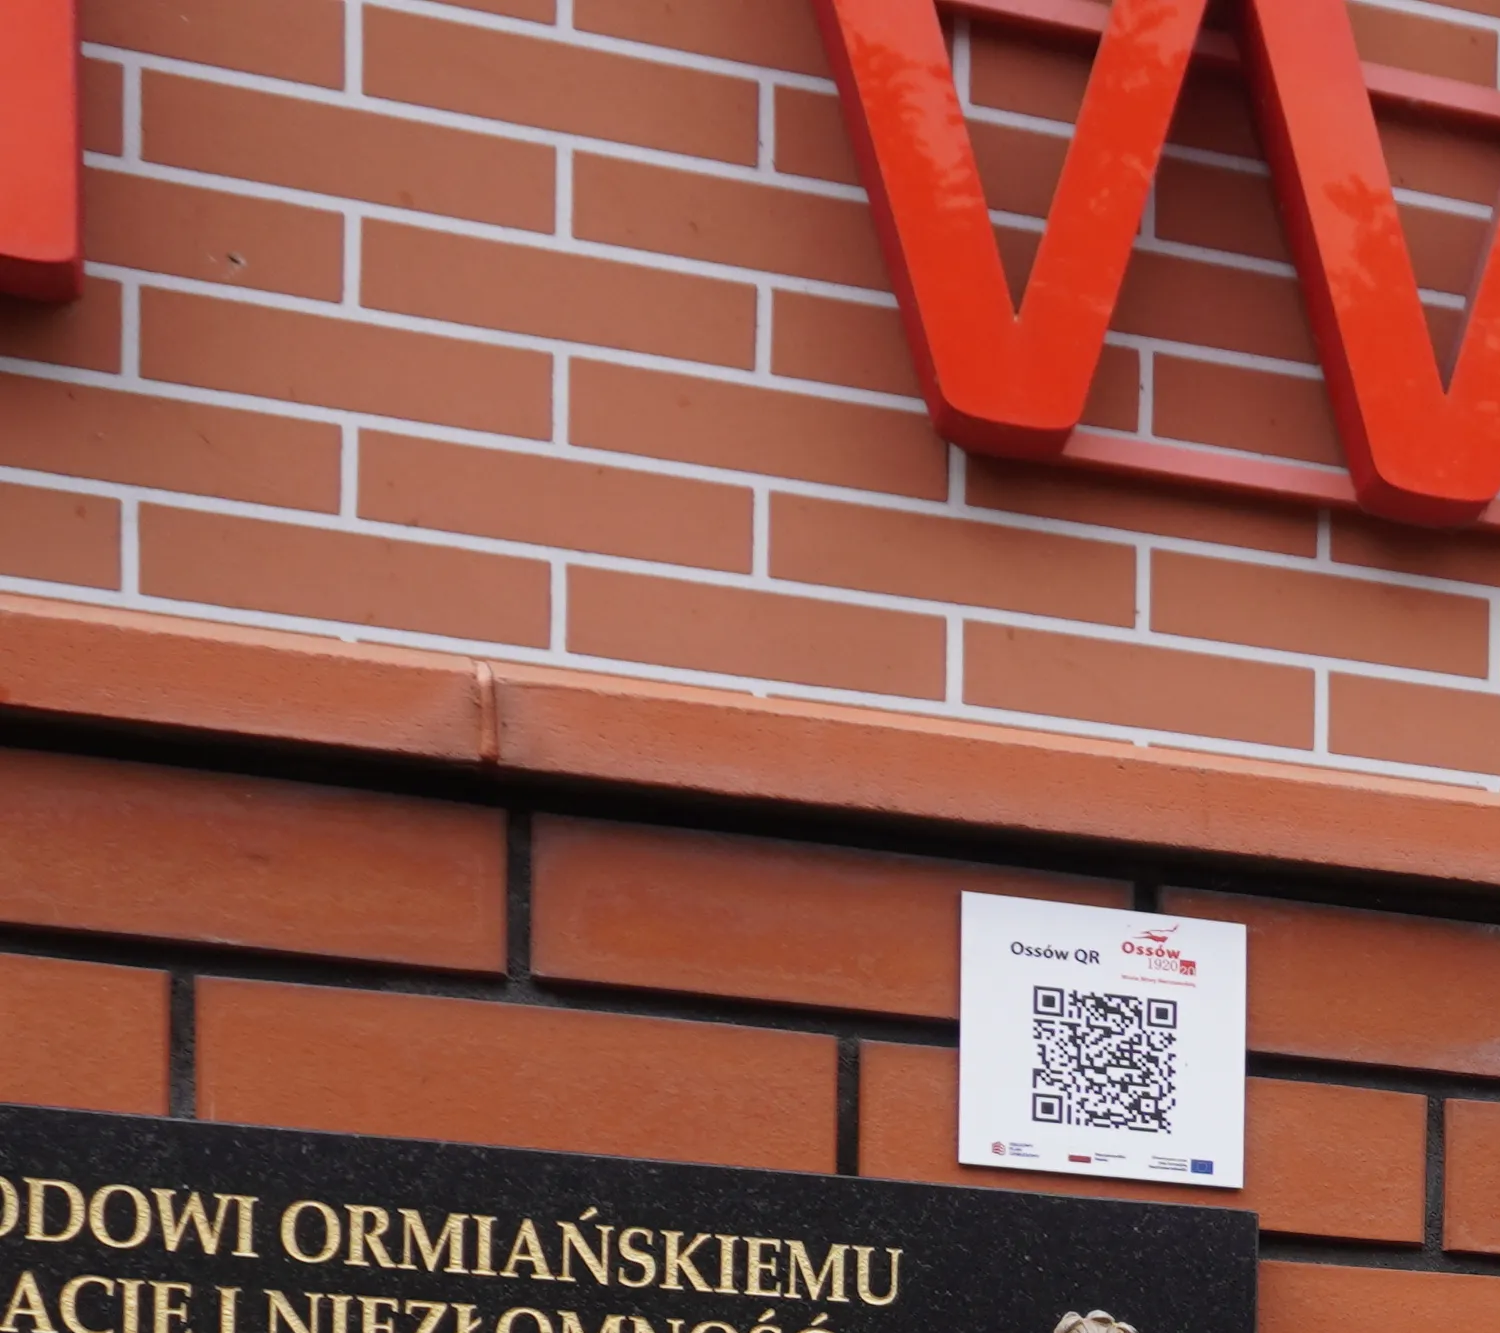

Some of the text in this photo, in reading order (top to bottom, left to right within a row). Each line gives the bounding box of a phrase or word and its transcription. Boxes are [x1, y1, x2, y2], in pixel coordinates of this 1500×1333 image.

[1010, 941, 1100, 966] Ossów QR
[1121, 941, 1181, 959] Ossów
[280, 1201, 903, 1306] ORMIAŃSKIEMU
